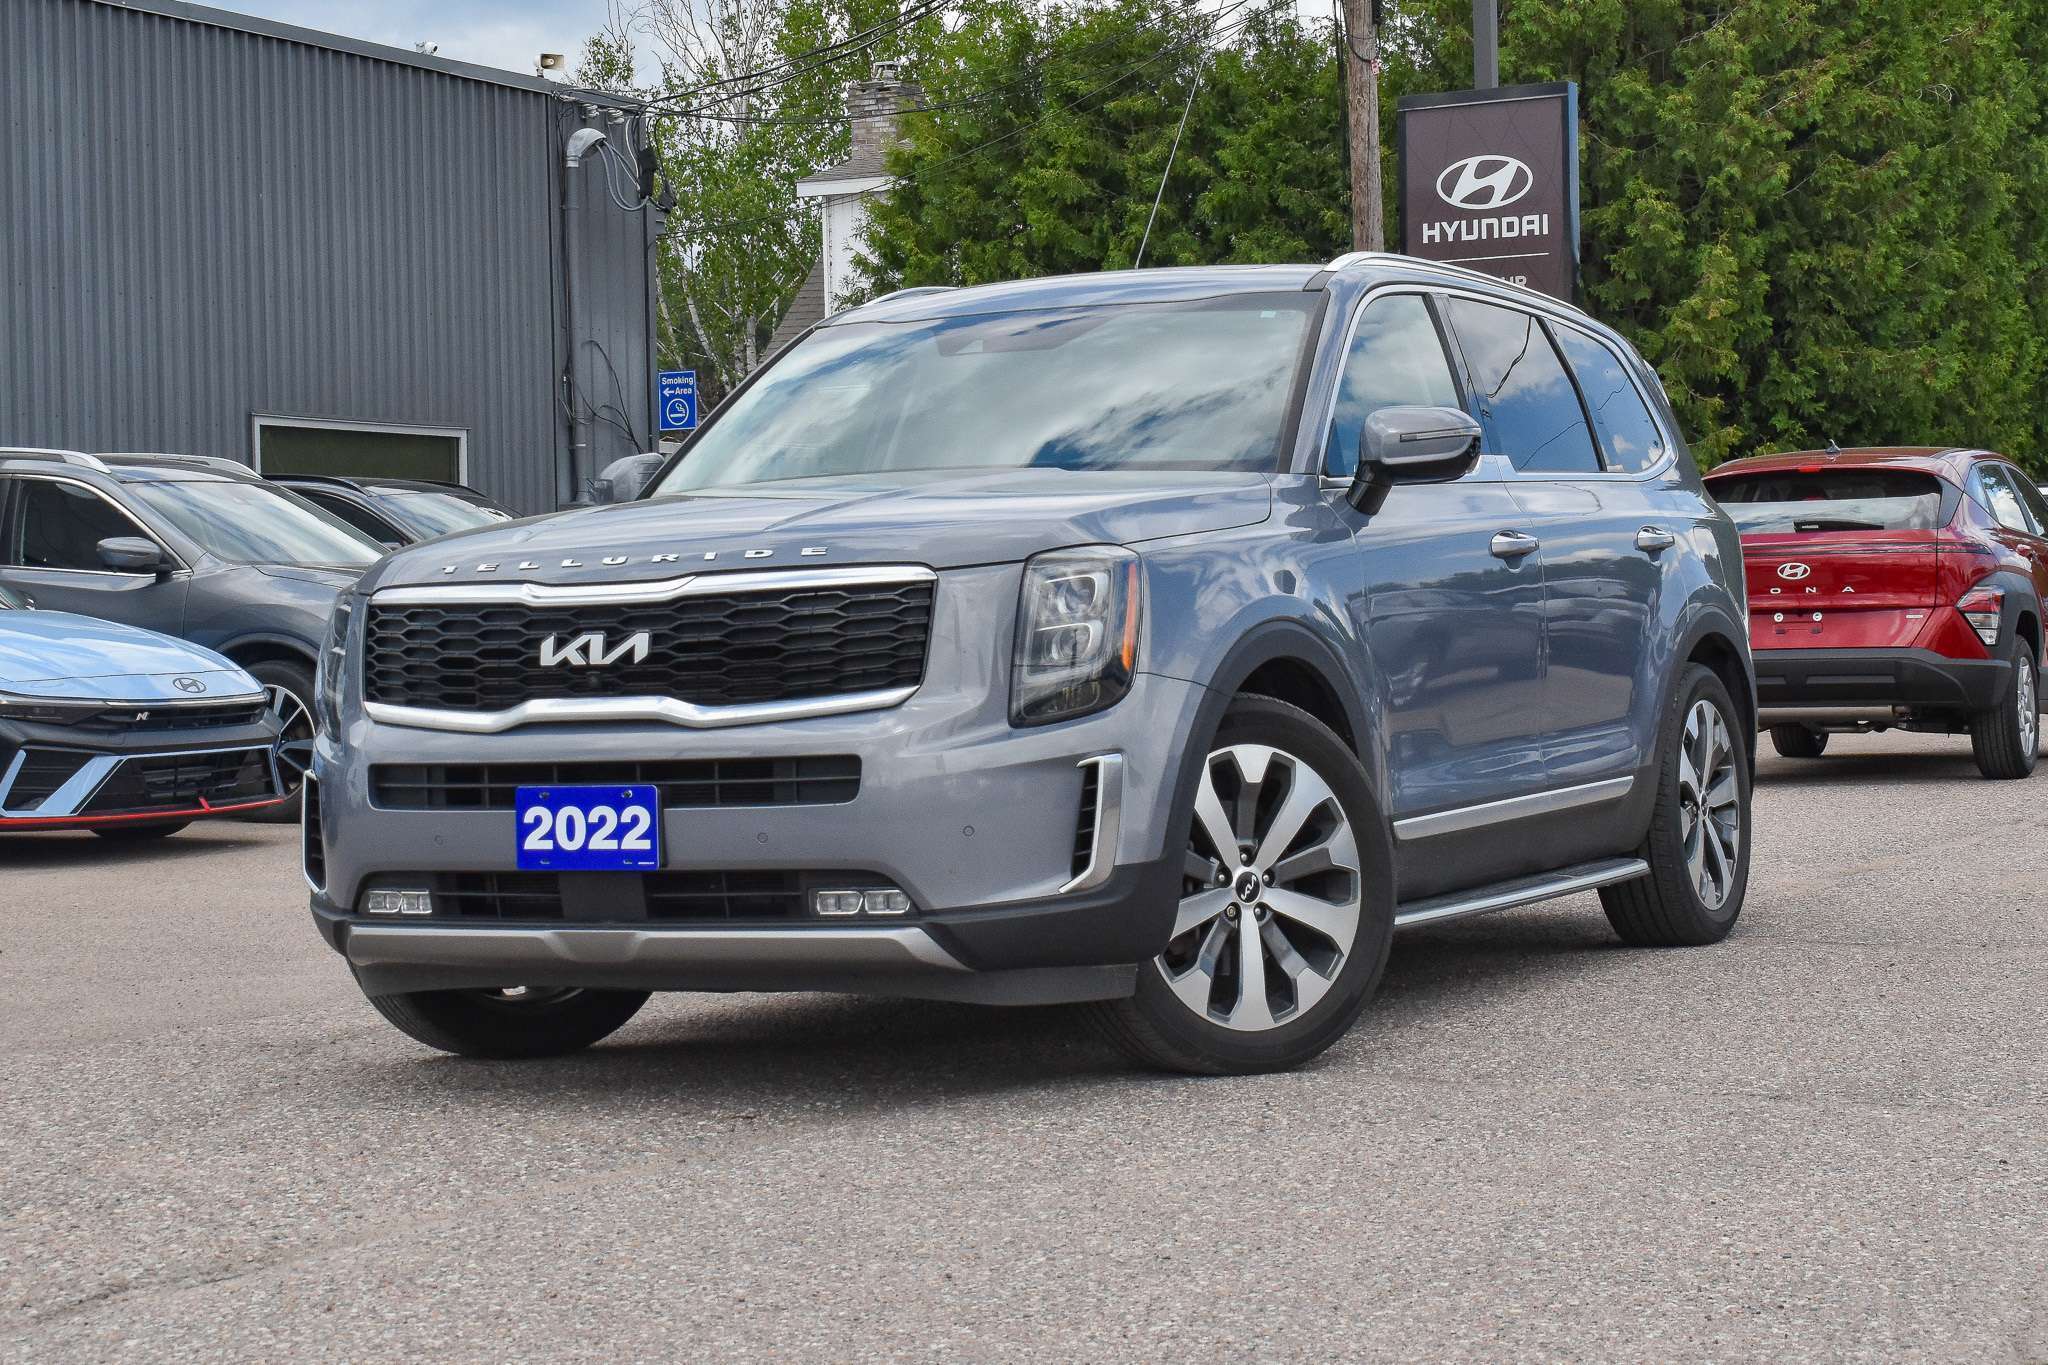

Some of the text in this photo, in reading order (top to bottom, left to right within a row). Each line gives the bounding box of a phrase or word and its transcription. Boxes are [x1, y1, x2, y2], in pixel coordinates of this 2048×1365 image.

[1422, 213, 1549, 244] HYUNDAI
[661, 376, 694, 386] Smoking
[674, 387, 693, 395] Area
[442, 546, 829, 574] TELLURIDE
[1769, 586, 1856, 595] ONA
[540, 630, 651, 666] KIA
[523, 805, 652, 851] 2022
